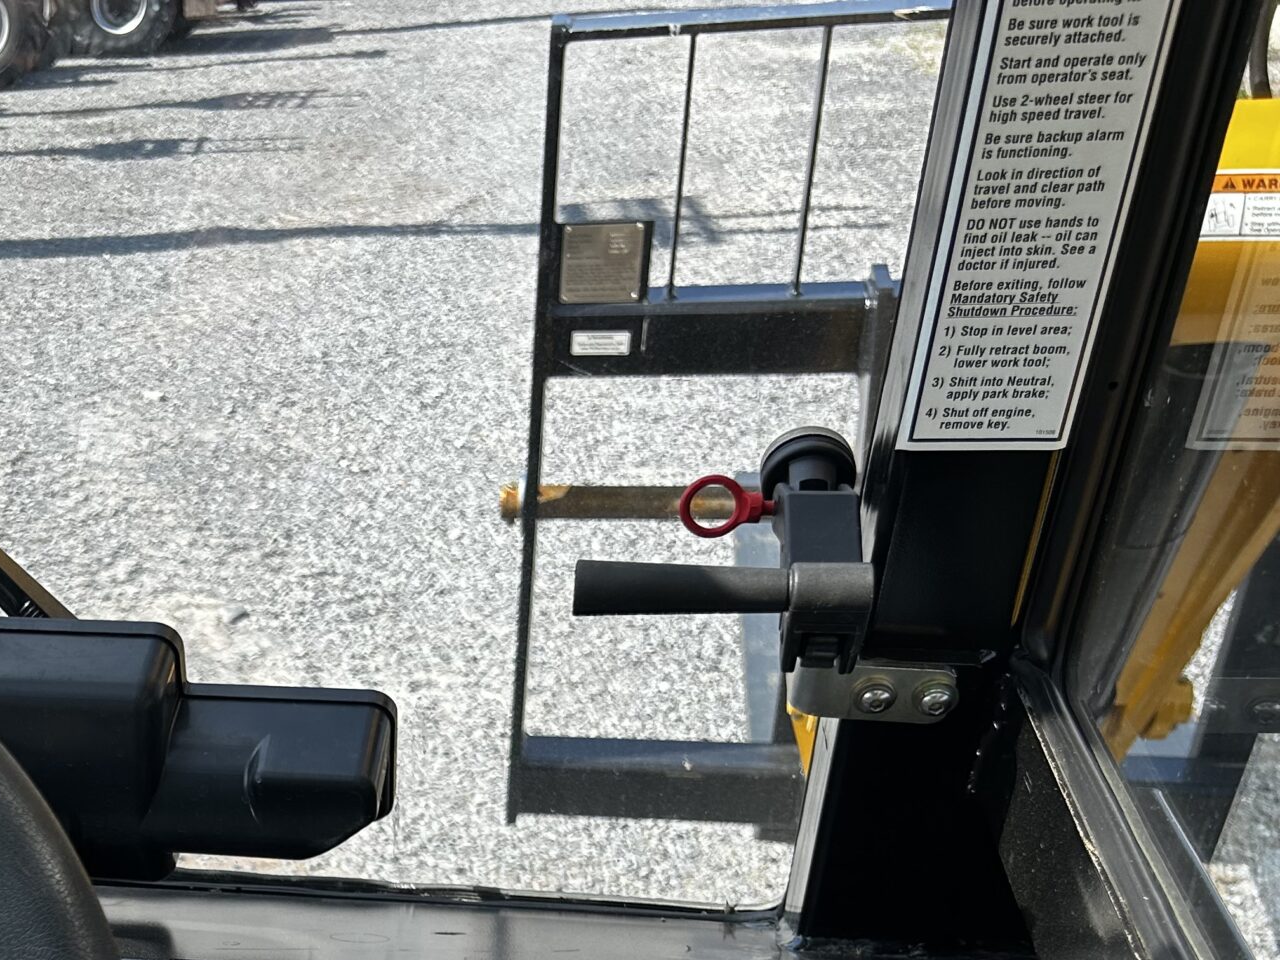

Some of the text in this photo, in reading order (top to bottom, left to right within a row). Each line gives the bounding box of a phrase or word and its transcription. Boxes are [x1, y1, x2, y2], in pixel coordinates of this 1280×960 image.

[1008, 13, 1140, 31] Be sure work tool is
[1004, 29, 1125, 47] securely attached.
[1000, 52, 1147, 70] Start and operate only
[997, 68, 1133, 86] from operator's seat.
[993, 91, 1133, 107] Use 2-wheel steer for
[989, 107, 1104, 124] high speed travel.
[985, 129, 1124, 145] Be sure backup alarm
[982, 145, 1072, 159] is functioning.
[977, 165, 1101, 181] Look in direction of
[974, 180, 1105, 195] travel and clear path
[971, 196, 1065, 209] before moving.
[967, 216, 1099, 230] DO NOT use hands to
[963, 233, 987, 244] find
[991, 232, 1007, 243] oil
[1011, 231, 1038, 243] leak
[1055, 230, 1072, 241] oil
[1075, 232, 1098, 241] can
[961, 244, 1096, 259] inject into skin. See a
[958, 258, 1059, 272] doctor if injured.
[953, 278, 1086, 291] Before exiting, follow
[950, 292, 1059, 305] Mandatory Safety
[947, 306, 1007, 317] Shutdown
[944, 324, 1072, 338] 1) Stop in level area;
[939, 345, 951, 358] 2)
[956, 345, 986, 357] Fully
[989, 345, 1029, 355] retract
[954, 358, 988, 368] lower
[991, 357, 1020, 367] work
[932, 377, 944, 389] 3)
[949, 377, 977, 387] Shift
[980, 377, 1003, 386] into
[946, 389, 978, 400] apply
[982, 389, 1008, 399] park
[925, 408, 937, 420] 4)
[943, 408, 969, 417] Shut
[972, 407, 989, 417] off
[940, 419, 1009, 431] remove key.
